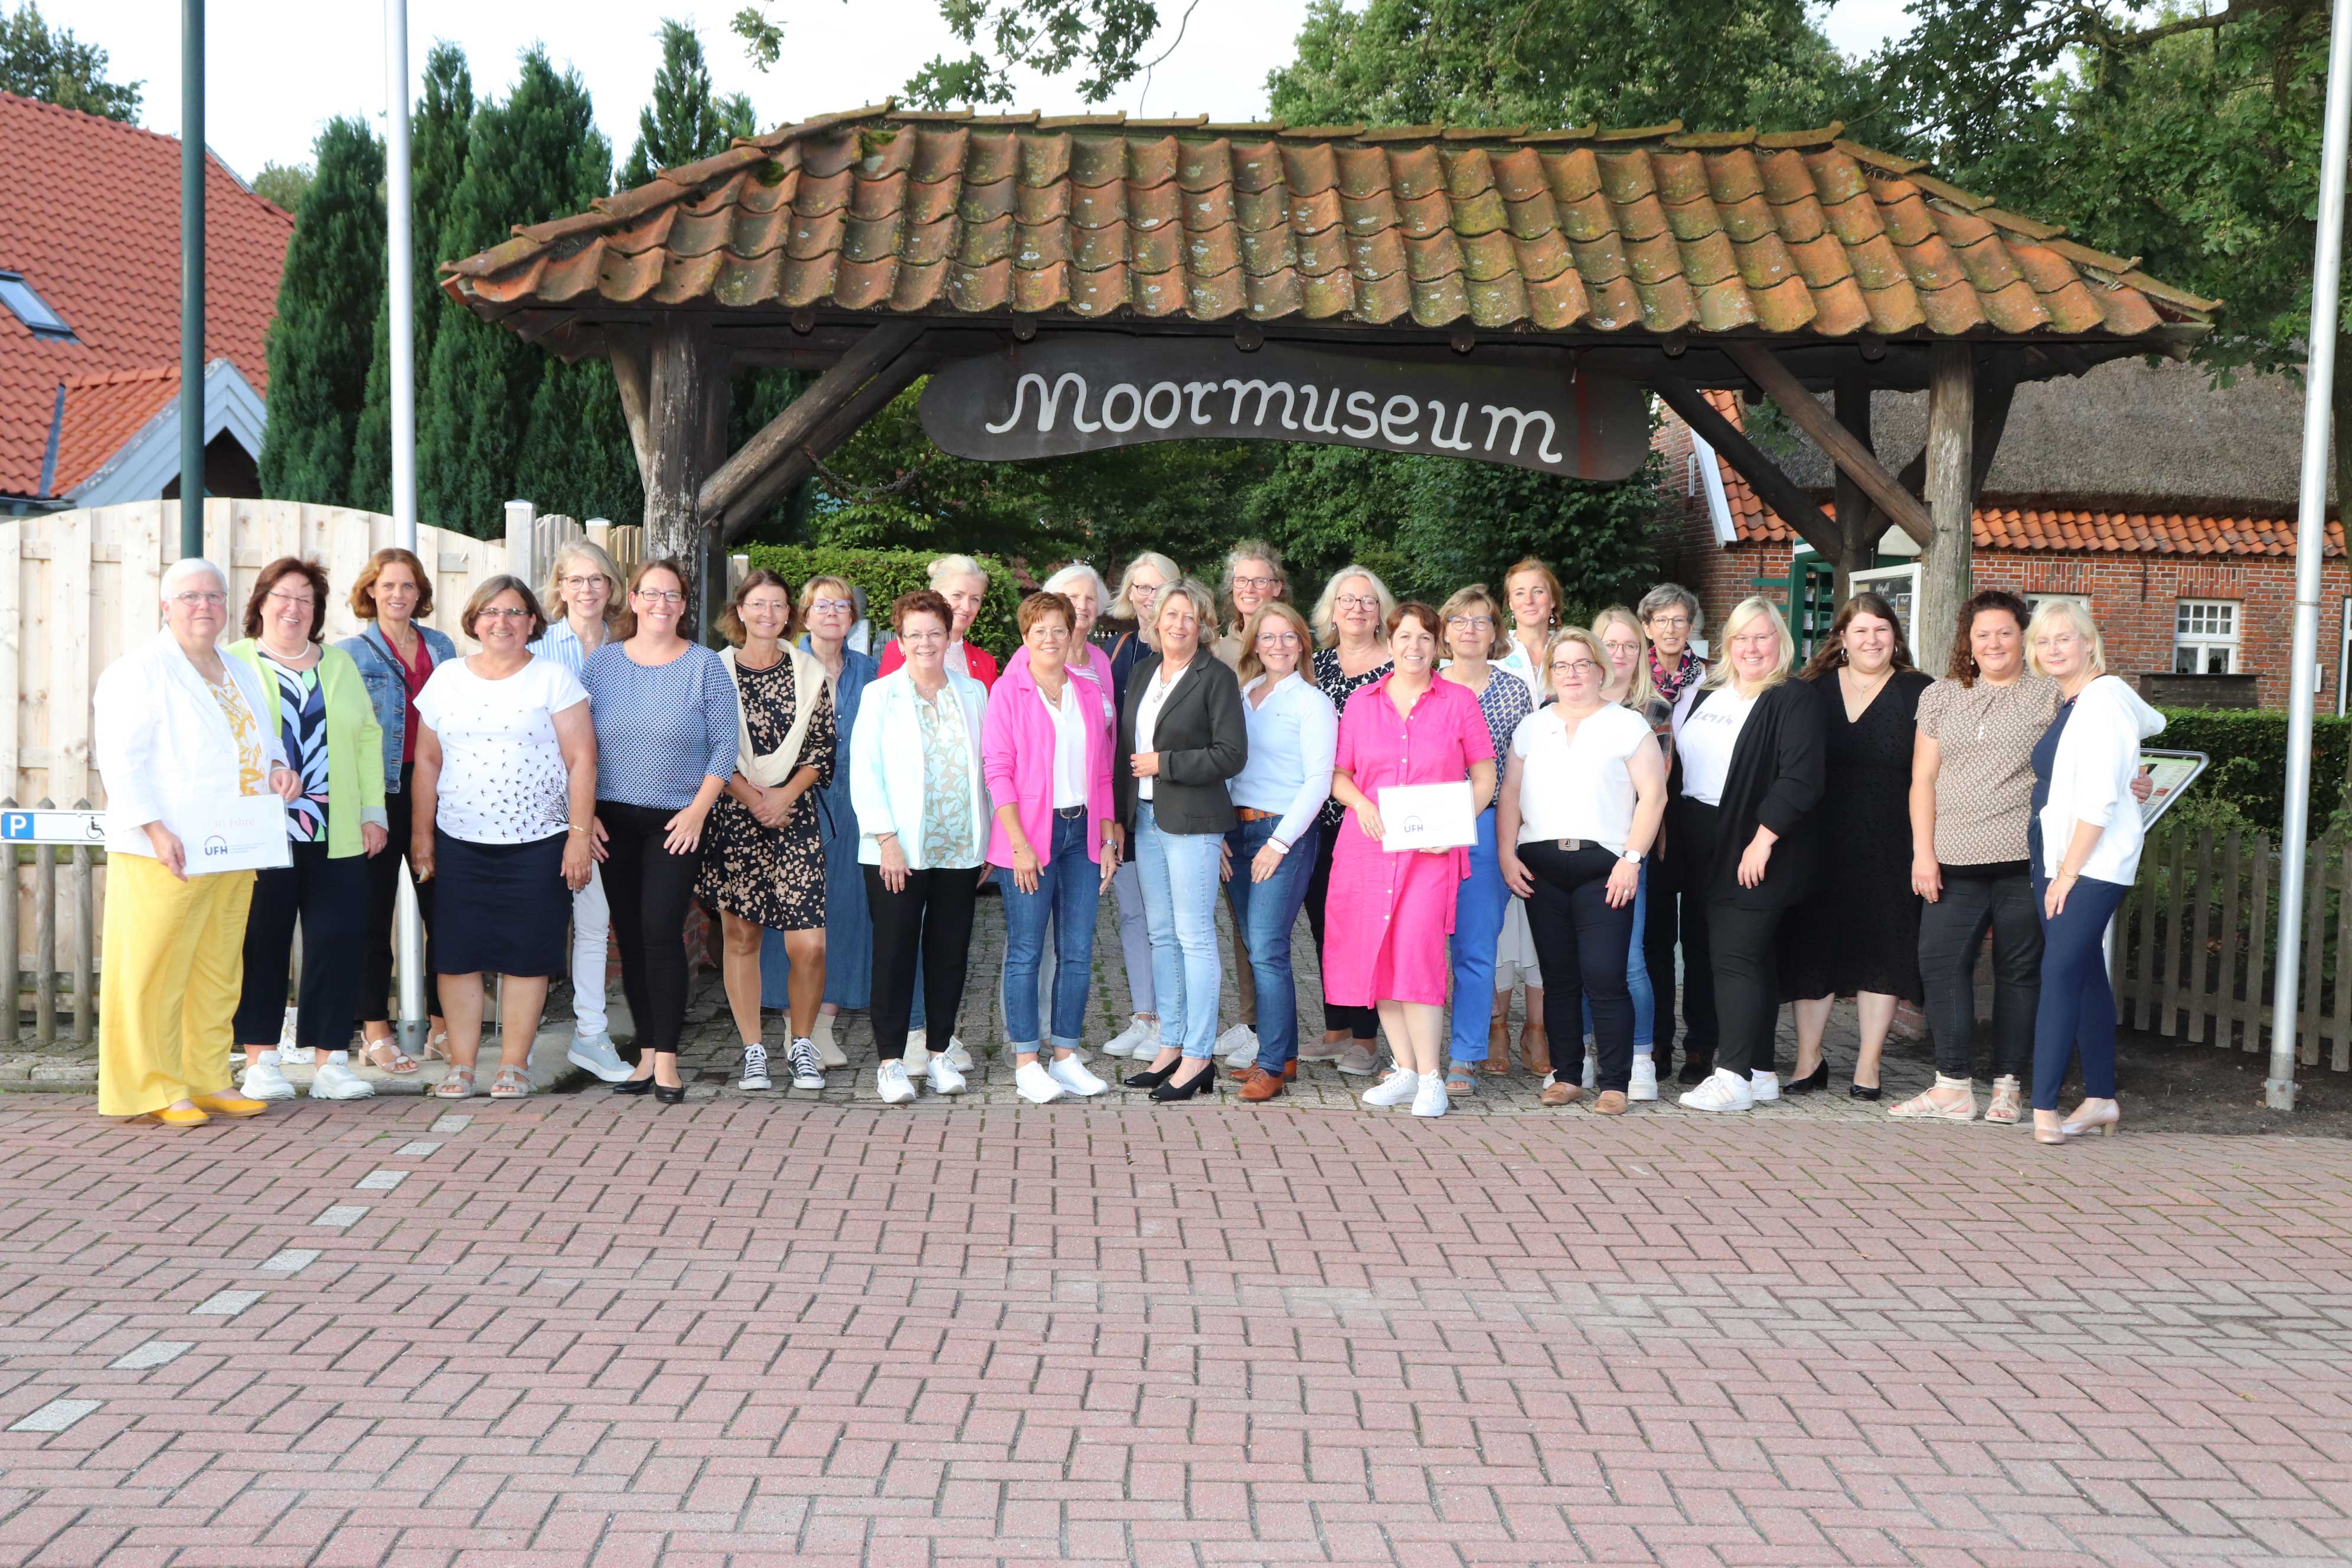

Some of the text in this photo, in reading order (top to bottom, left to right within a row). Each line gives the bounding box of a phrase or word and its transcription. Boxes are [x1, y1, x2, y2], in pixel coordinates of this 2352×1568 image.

[985, 372, 1563, 463] Moormuseum
[10, 815, 27, 837] P
[1404, 824, 1423, 832] UFH
[205, 845, 228, 855] UFH
